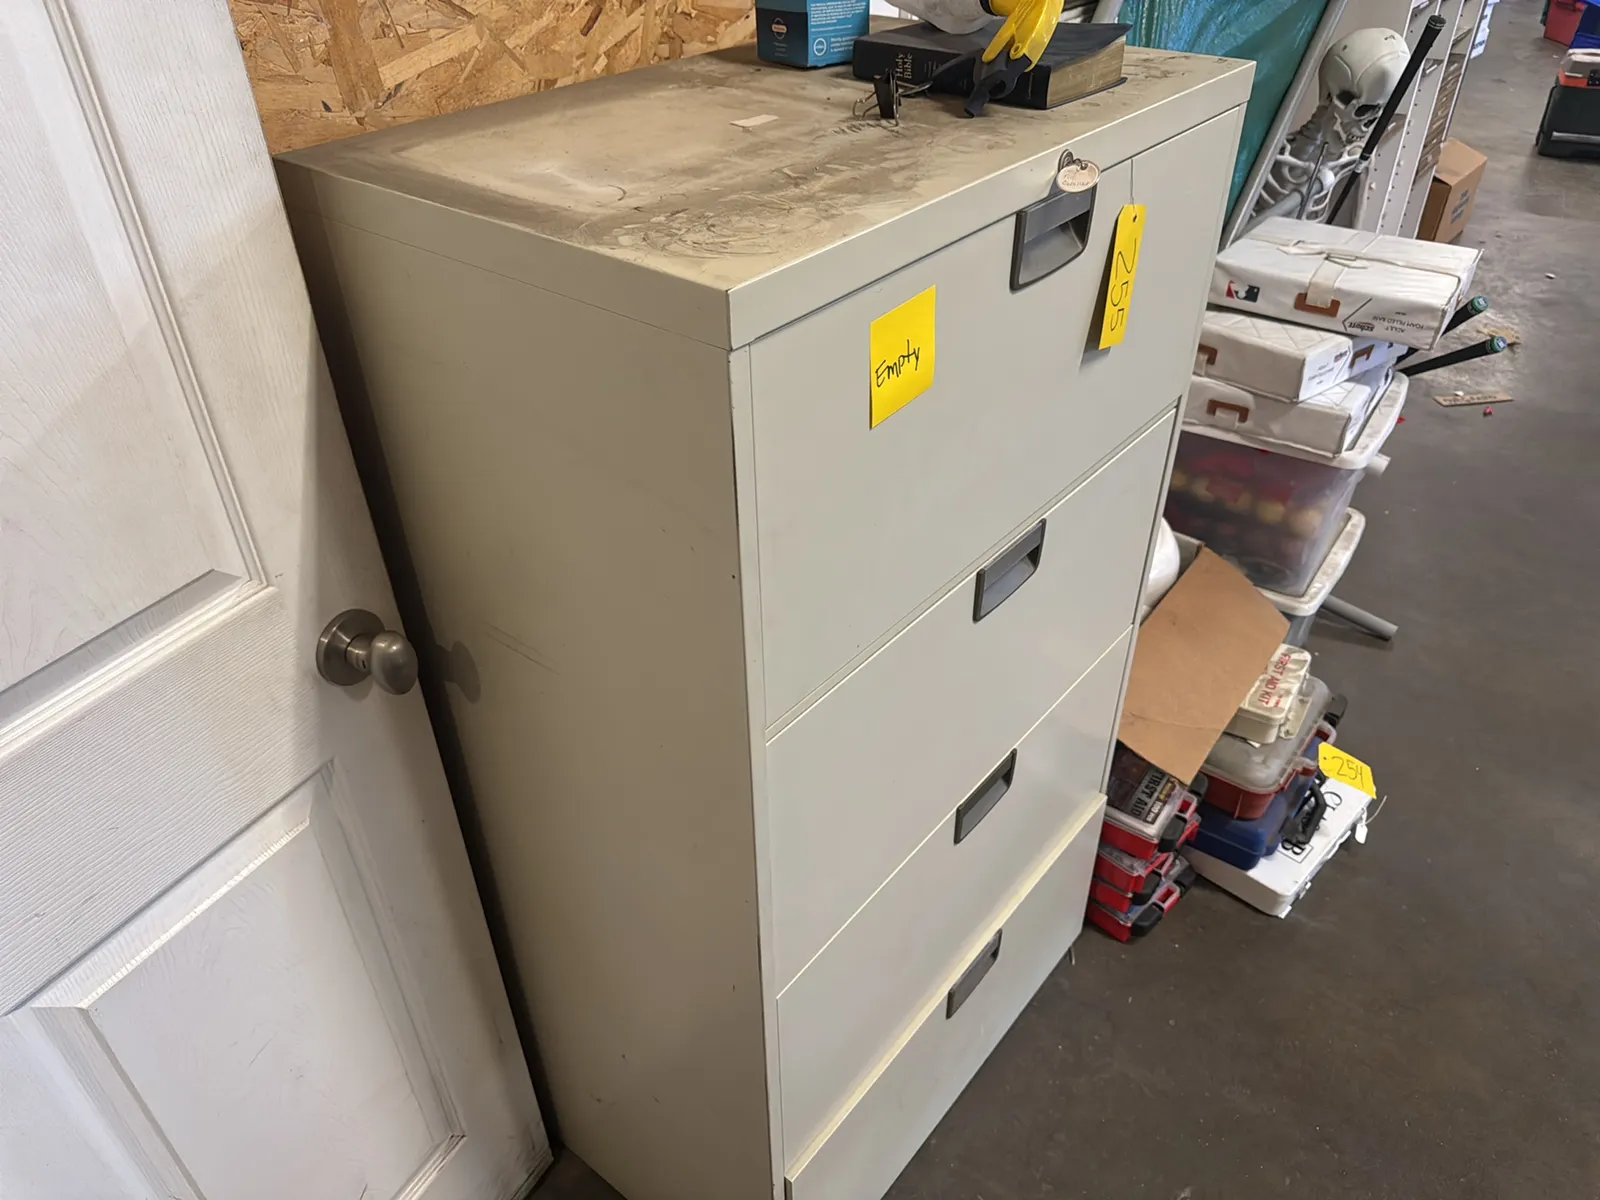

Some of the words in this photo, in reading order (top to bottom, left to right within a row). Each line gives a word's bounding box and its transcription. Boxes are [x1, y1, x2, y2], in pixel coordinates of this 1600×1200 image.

[895, 53, 905, 77] Holy
[904, 52, 913, 79] Bible
[1110, 238, 1138, 332] 255
[875, 339, 920, 388] Empty
[1272, 652, 1291, 676] FIRST
[1257, 689, 1272, 705] KIT
[1331, 755, 1364, 789] 254
[1130, 797, 1148, 817] AID
